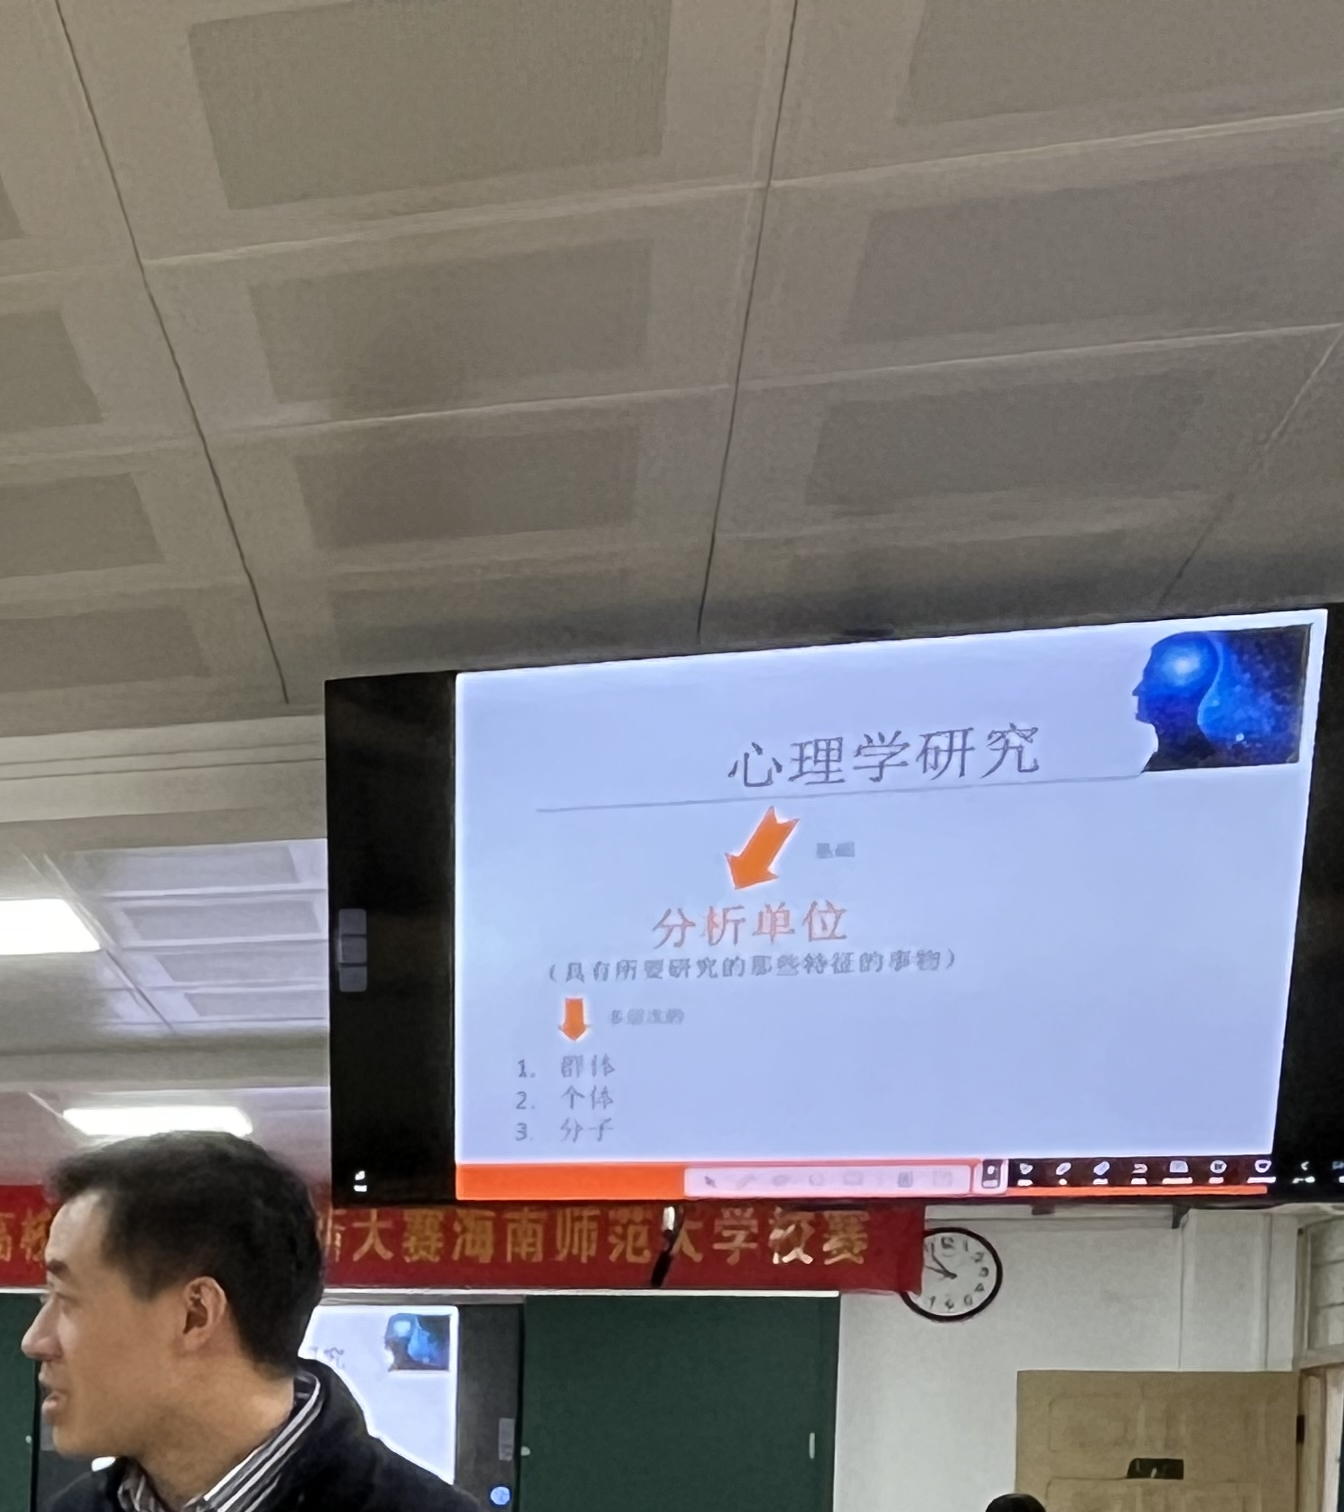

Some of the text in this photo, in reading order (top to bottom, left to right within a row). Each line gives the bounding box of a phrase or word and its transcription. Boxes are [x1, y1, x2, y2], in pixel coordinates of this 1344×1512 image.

[727, 721, 1040, 788] 心理学研究
[652, 898, 849, 950] 分析单位
[559, 1084, 615, 1111] 个体
